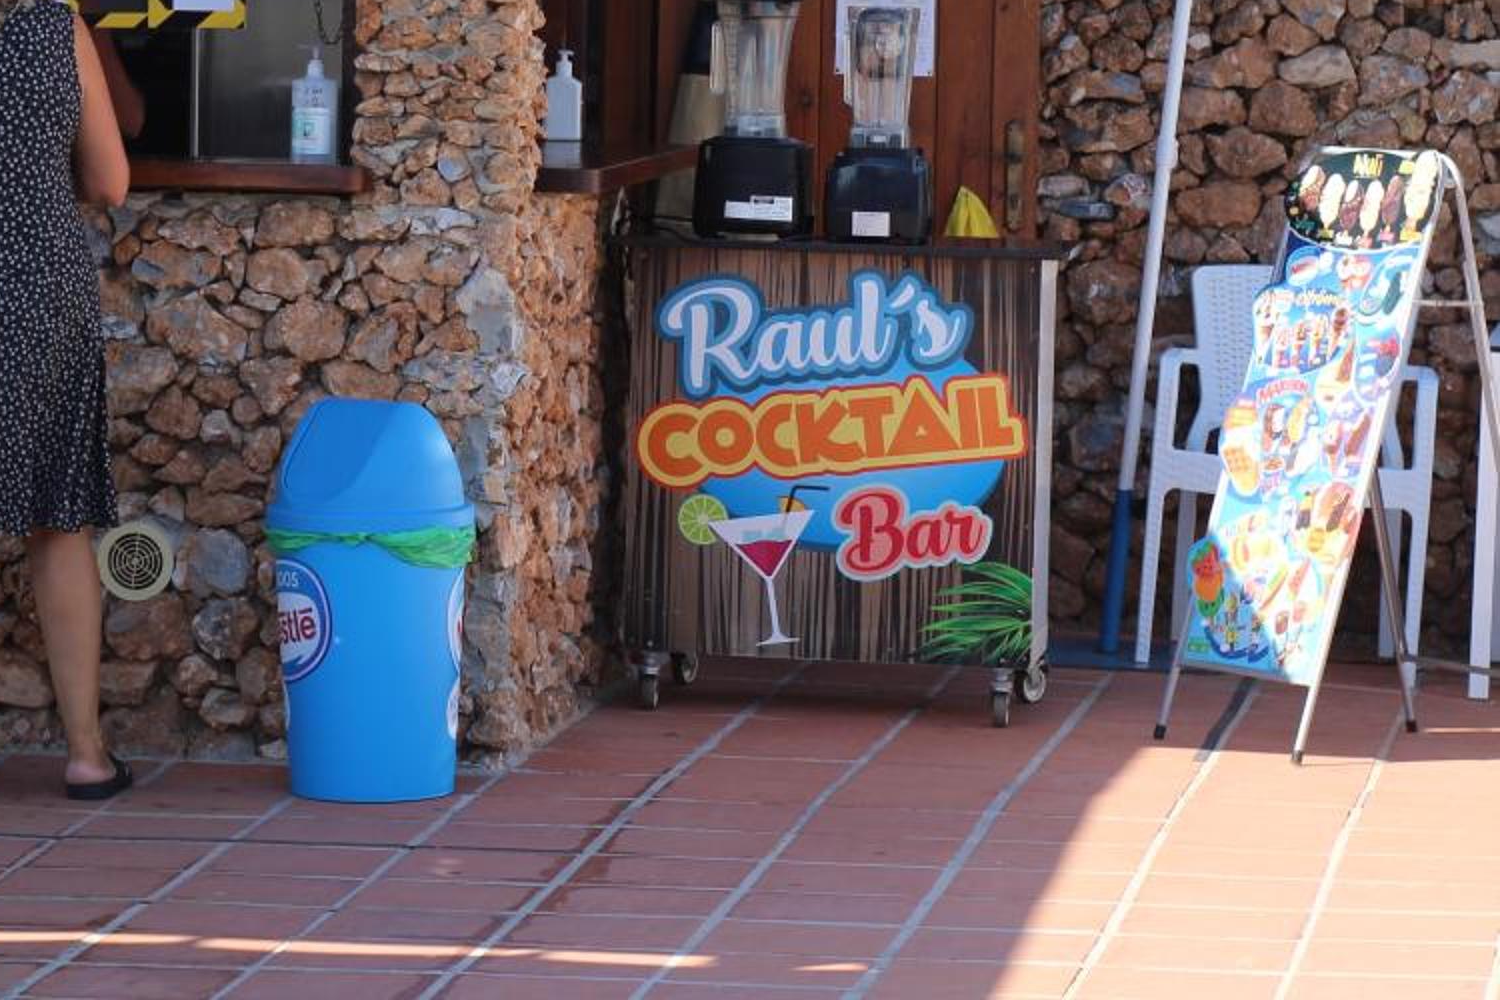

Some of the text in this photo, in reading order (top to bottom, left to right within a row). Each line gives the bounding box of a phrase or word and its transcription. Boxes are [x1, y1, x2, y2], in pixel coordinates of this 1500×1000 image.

[663, 275, 966, 393] Raul's
[643, 382, 1020, 475] COCKTAIL
[838, 489, 988, 574] Bar
